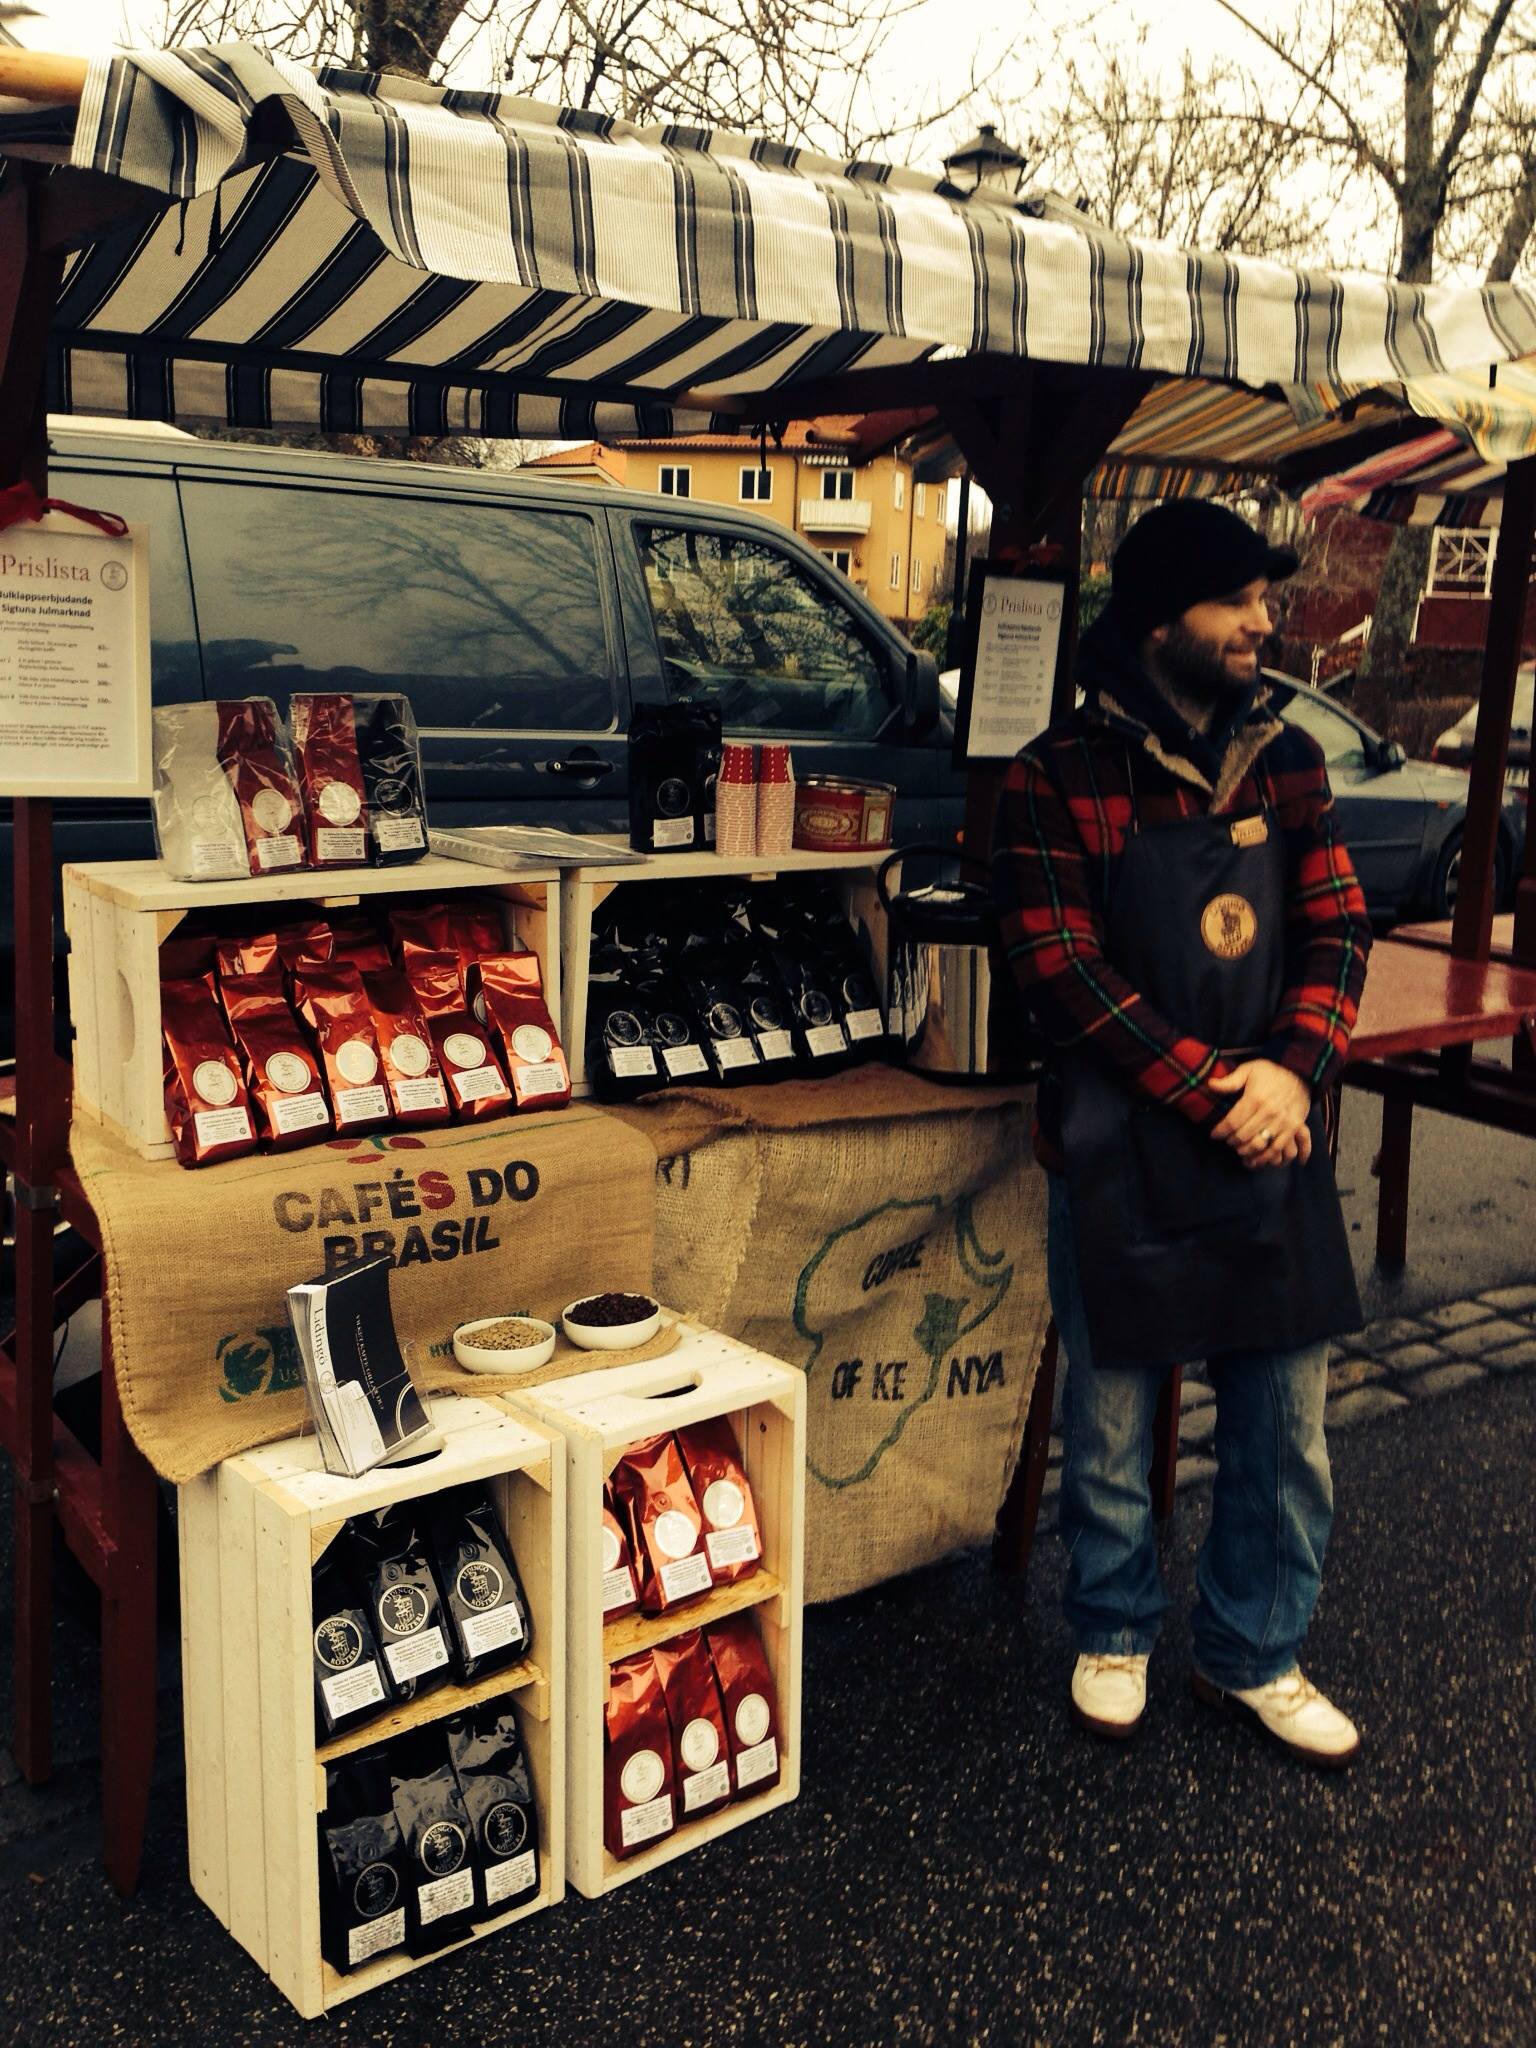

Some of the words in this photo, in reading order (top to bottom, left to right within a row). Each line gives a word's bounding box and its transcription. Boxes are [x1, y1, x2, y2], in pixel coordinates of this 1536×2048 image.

[1, 554, 91, 582] Prislista
[2, 604, 36, 615] Sigtuna
[39, 606, 91, 618] Julmarknad
[1001, 595, 1042, 616] Prislista
[273, 1168, 456, 1233] CAFÉS
[466, 1160, 540, 1207] DO
[322, 1216, 500, 1275] BRASIL
[831, 1358, 863, 1399] OF
